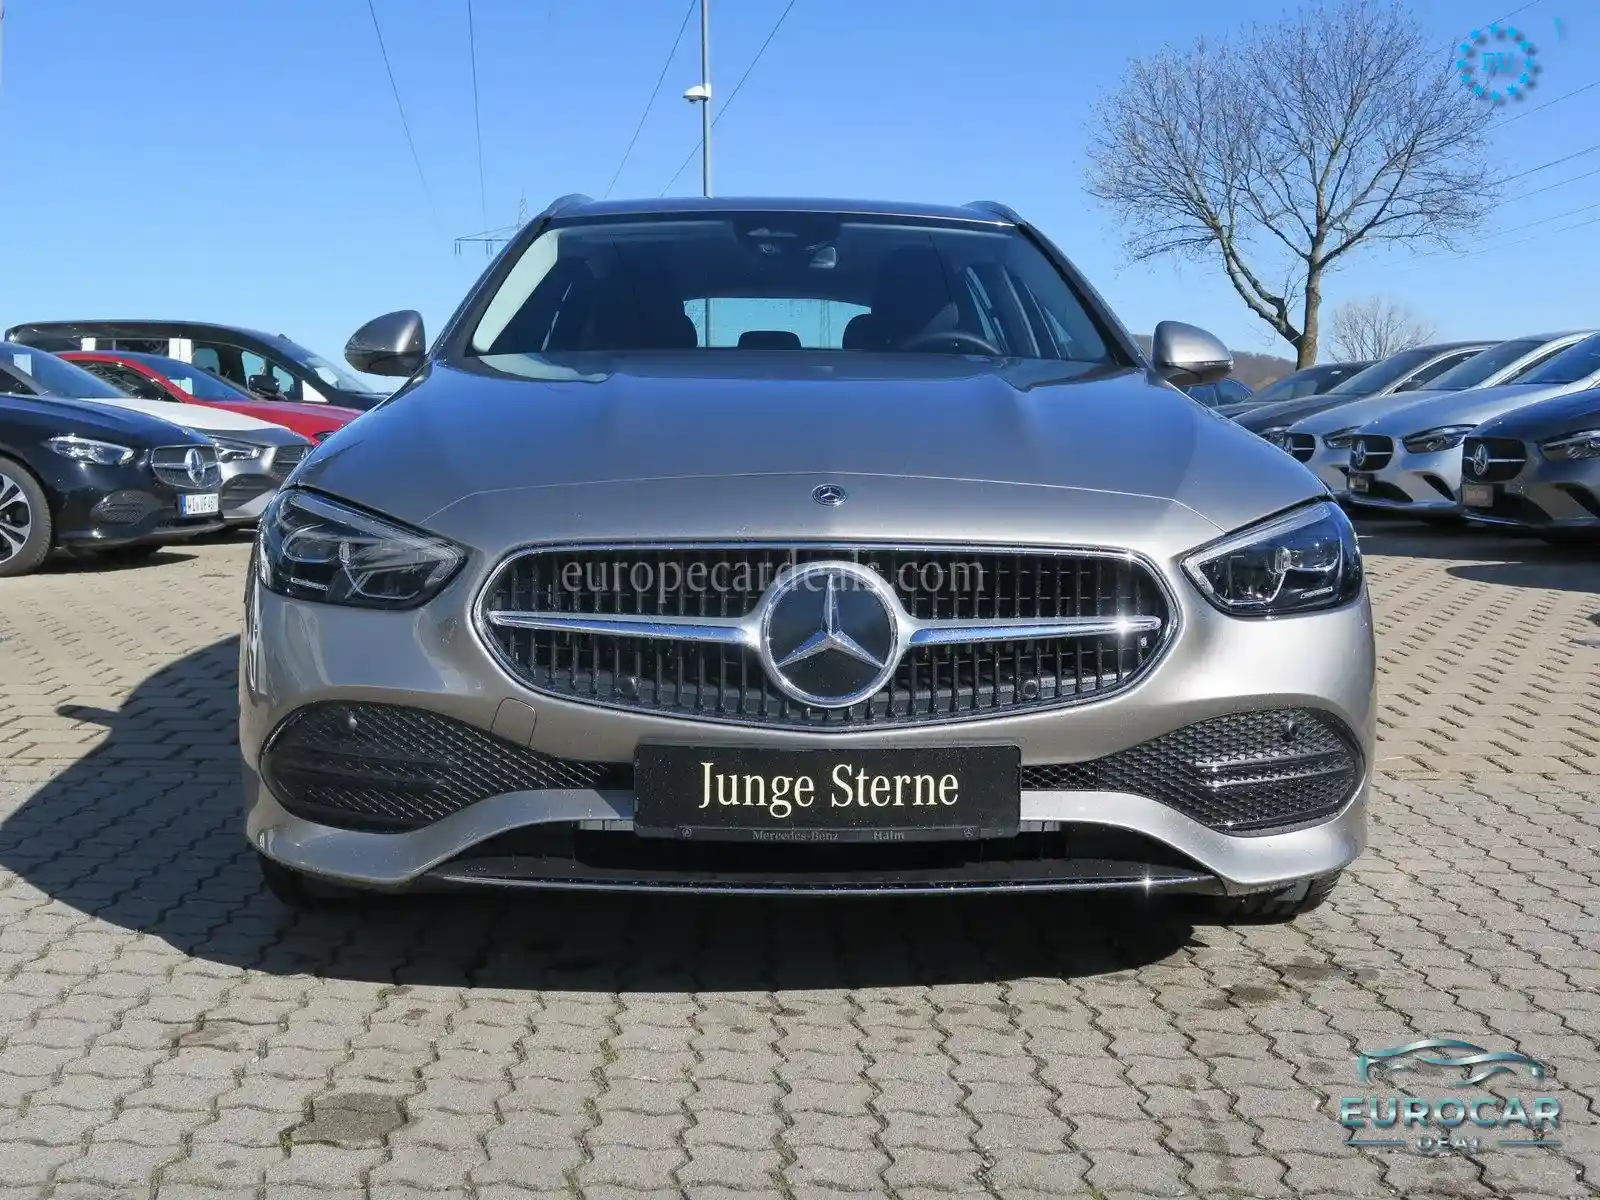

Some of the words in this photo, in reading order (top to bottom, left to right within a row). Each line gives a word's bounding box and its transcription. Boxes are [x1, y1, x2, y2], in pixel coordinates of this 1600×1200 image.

[698, 762, 815, 819] Junge
[831, 763, 958, 808] Sterne
[752, 830, 839, 841] Mercedes-Benz
